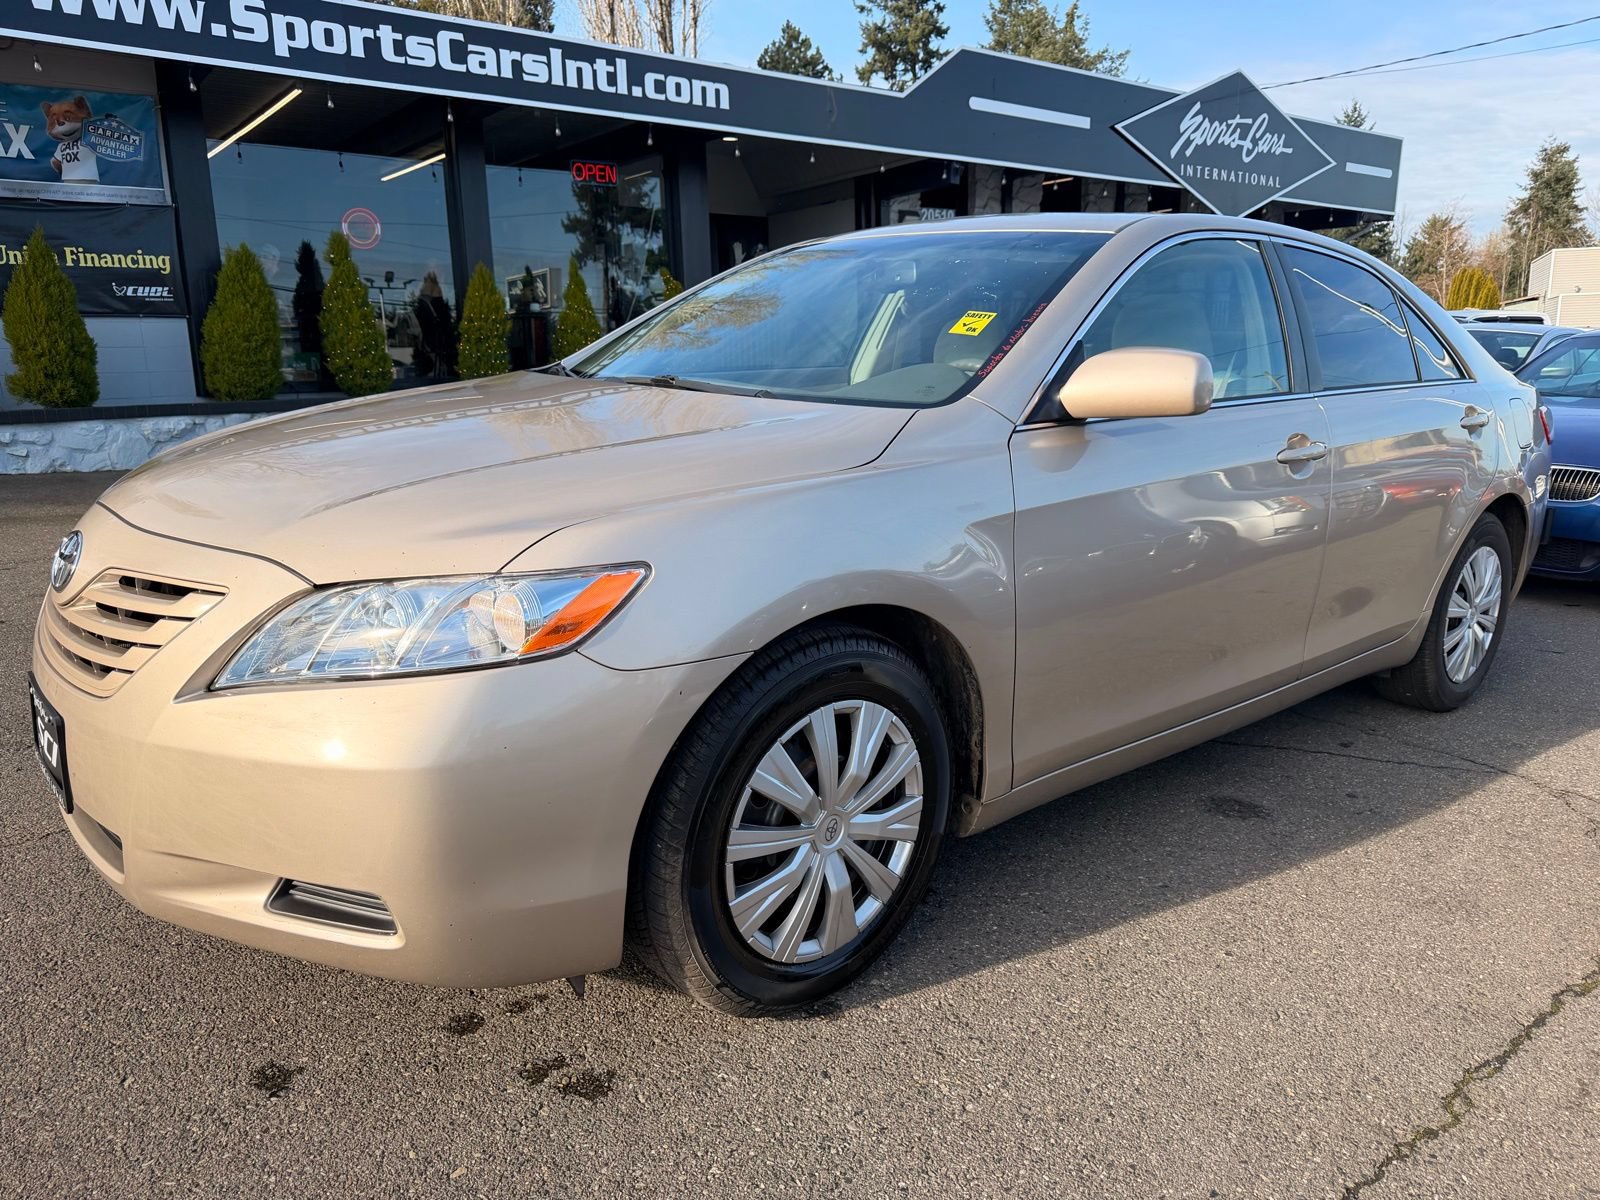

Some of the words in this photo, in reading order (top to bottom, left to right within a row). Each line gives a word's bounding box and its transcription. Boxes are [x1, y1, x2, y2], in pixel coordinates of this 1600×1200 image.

[87, 124, 140, 146] CARFAX
[1170, 101, 1252, 159] Sports
[1241, 112, 1293, 163] Cars
[60, 140, 81, 152] CAR
[90, 135, 135, 153] ADVANTAGE
[96, 145, 127, 159] DEALER
[61, 151, 81, 163] FOX
[572, 162, 617, 183] OPEN
[1180, 163, 1281, 188] INTERNATIONAL
[63, 246, 171, 274] Financing
[964, 312, 993, 320] SAFETY
